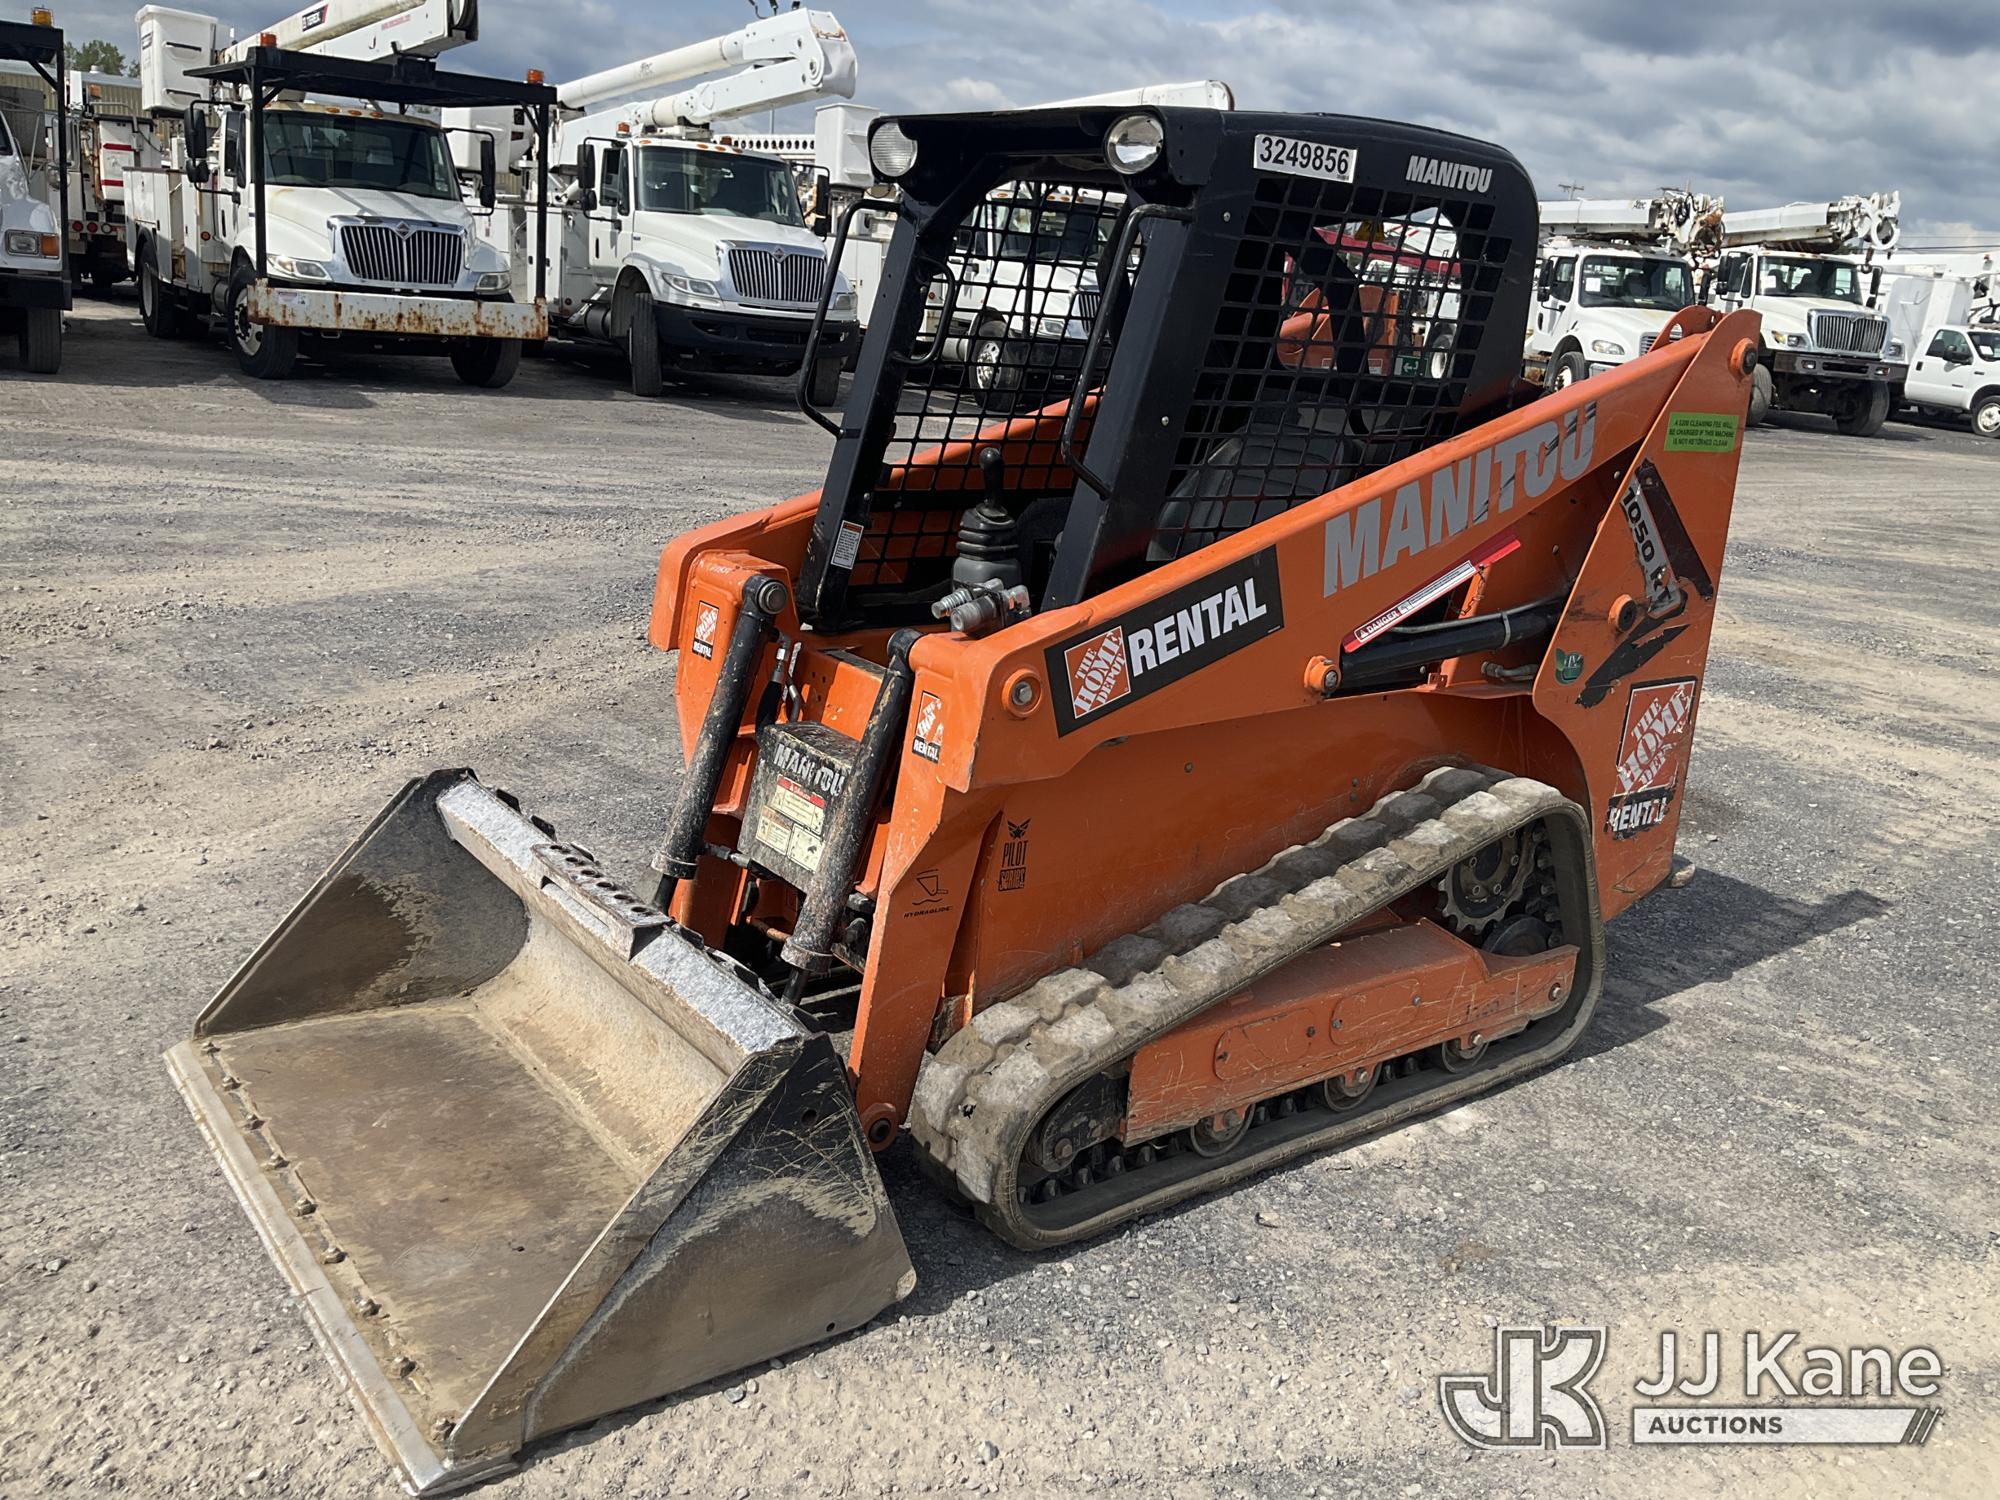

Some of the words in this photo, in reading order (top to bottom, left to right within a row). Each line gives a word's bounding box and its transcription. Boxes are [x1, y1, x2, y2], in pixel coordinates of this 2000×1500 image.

[1259, 136, 1350, 176] 3249856
[1406, 154, 1493, 194] MANITOU
[1323, 400, 1598, 599] MANITOU
[1623, 486, 1655, 562] 1050
[1128, 577, 1267, 677] RENTAL
[1366, 610, 1400, 634] DANGER
[1074, 630, 1123, 713] HOME
[1075, 647, 1098, 681] THE
[1095, 650, 1127, 705] DEPOT
[1630, 697, 1661, 742] THE
[1002, 840, 1029, 868] PILOT
